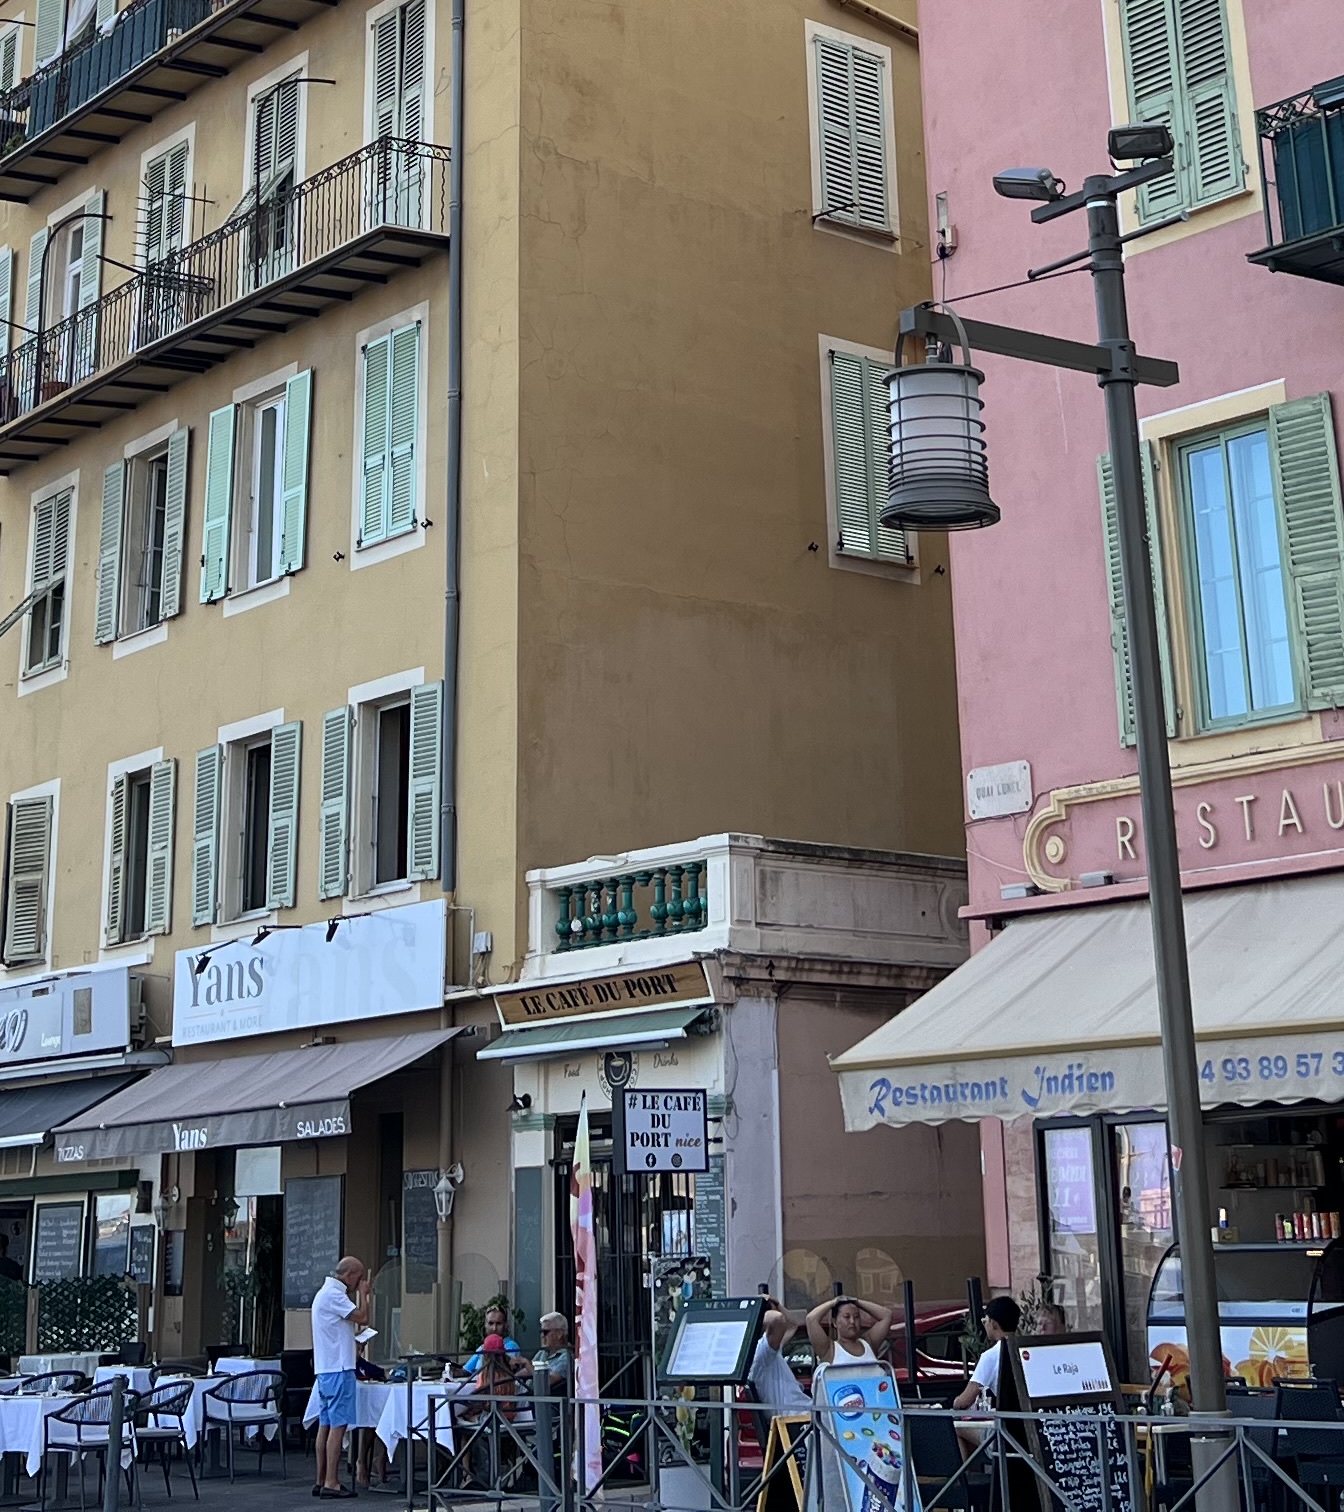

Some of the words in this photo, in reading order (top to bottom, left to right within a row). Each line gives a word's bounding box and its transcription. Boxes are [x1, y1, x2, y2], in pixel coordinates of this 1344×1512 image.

[976, 785, 993, 800] QUAI
[186, 954, 264, 1008] Yans
[520, 996, 546, 1015] LE
[545, 982, 593, 1011] CAFÉ
[595, 983, 621, 1002] DU
[623, 974, 678, 999] PORT
[182, 1019, 232, 1038] RESTAURANT
[239, 1014, 263, 1029] MORE
[563, 1064, 580, 1078] Food
[653, 1052, 679, 1069] Drinks
[1201, 1059, 1215, 1082] 4
[1221, 1057, 1251, 1081] 93
[1258, 1055, 1287, 1080] 89
[1296, 1053, 1323, 1078] 57
[641, 1094, 660, 1110] LE
[664, 1092, 702, 1112] CAFÉ
[868, 1077, 1009, 1118] Restaurant
[1020, 1062, 1115, 1109] Indien
[172, 1122, 207, 1150] Yans
[296, 1116, 345, 1138] SALADES
[650, 1114, 671, 1129] DU
[630, 1132, 671, 1147] PORT
[675, 1133, 702, 1147] nice
[1053, 1364, 1062, 1375] Le
[1063, 1363, 1079, 1375] Raja
